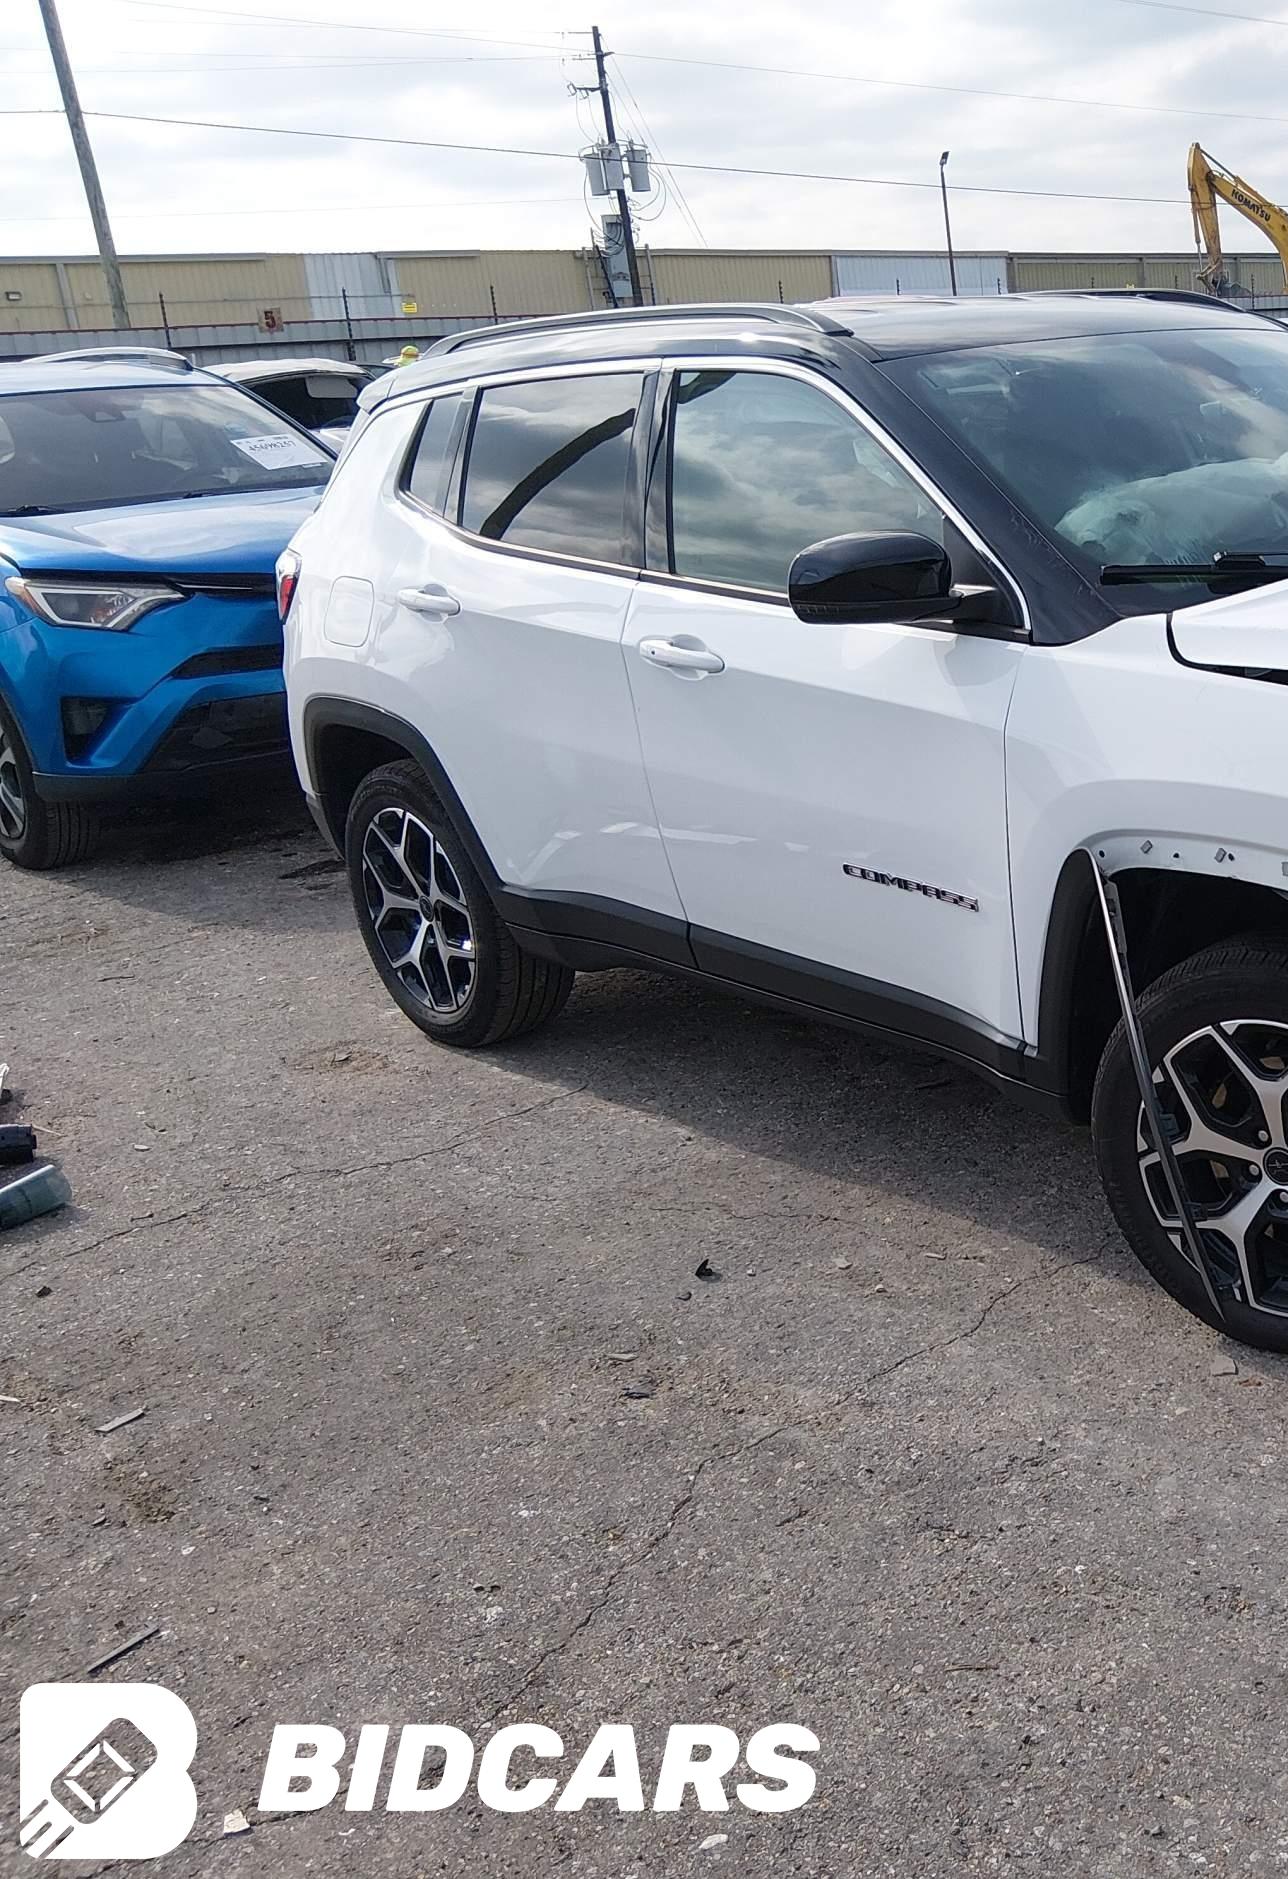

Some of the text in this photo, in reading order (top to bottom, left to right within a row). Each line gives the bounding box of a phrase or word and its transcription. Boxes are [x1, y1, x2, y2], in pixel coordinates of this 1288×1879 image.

[1231, 188, 1272, 222] KOMATSU
[263, 310, 277, 329] 5
[842, 862, 979, 913] COMPASS
